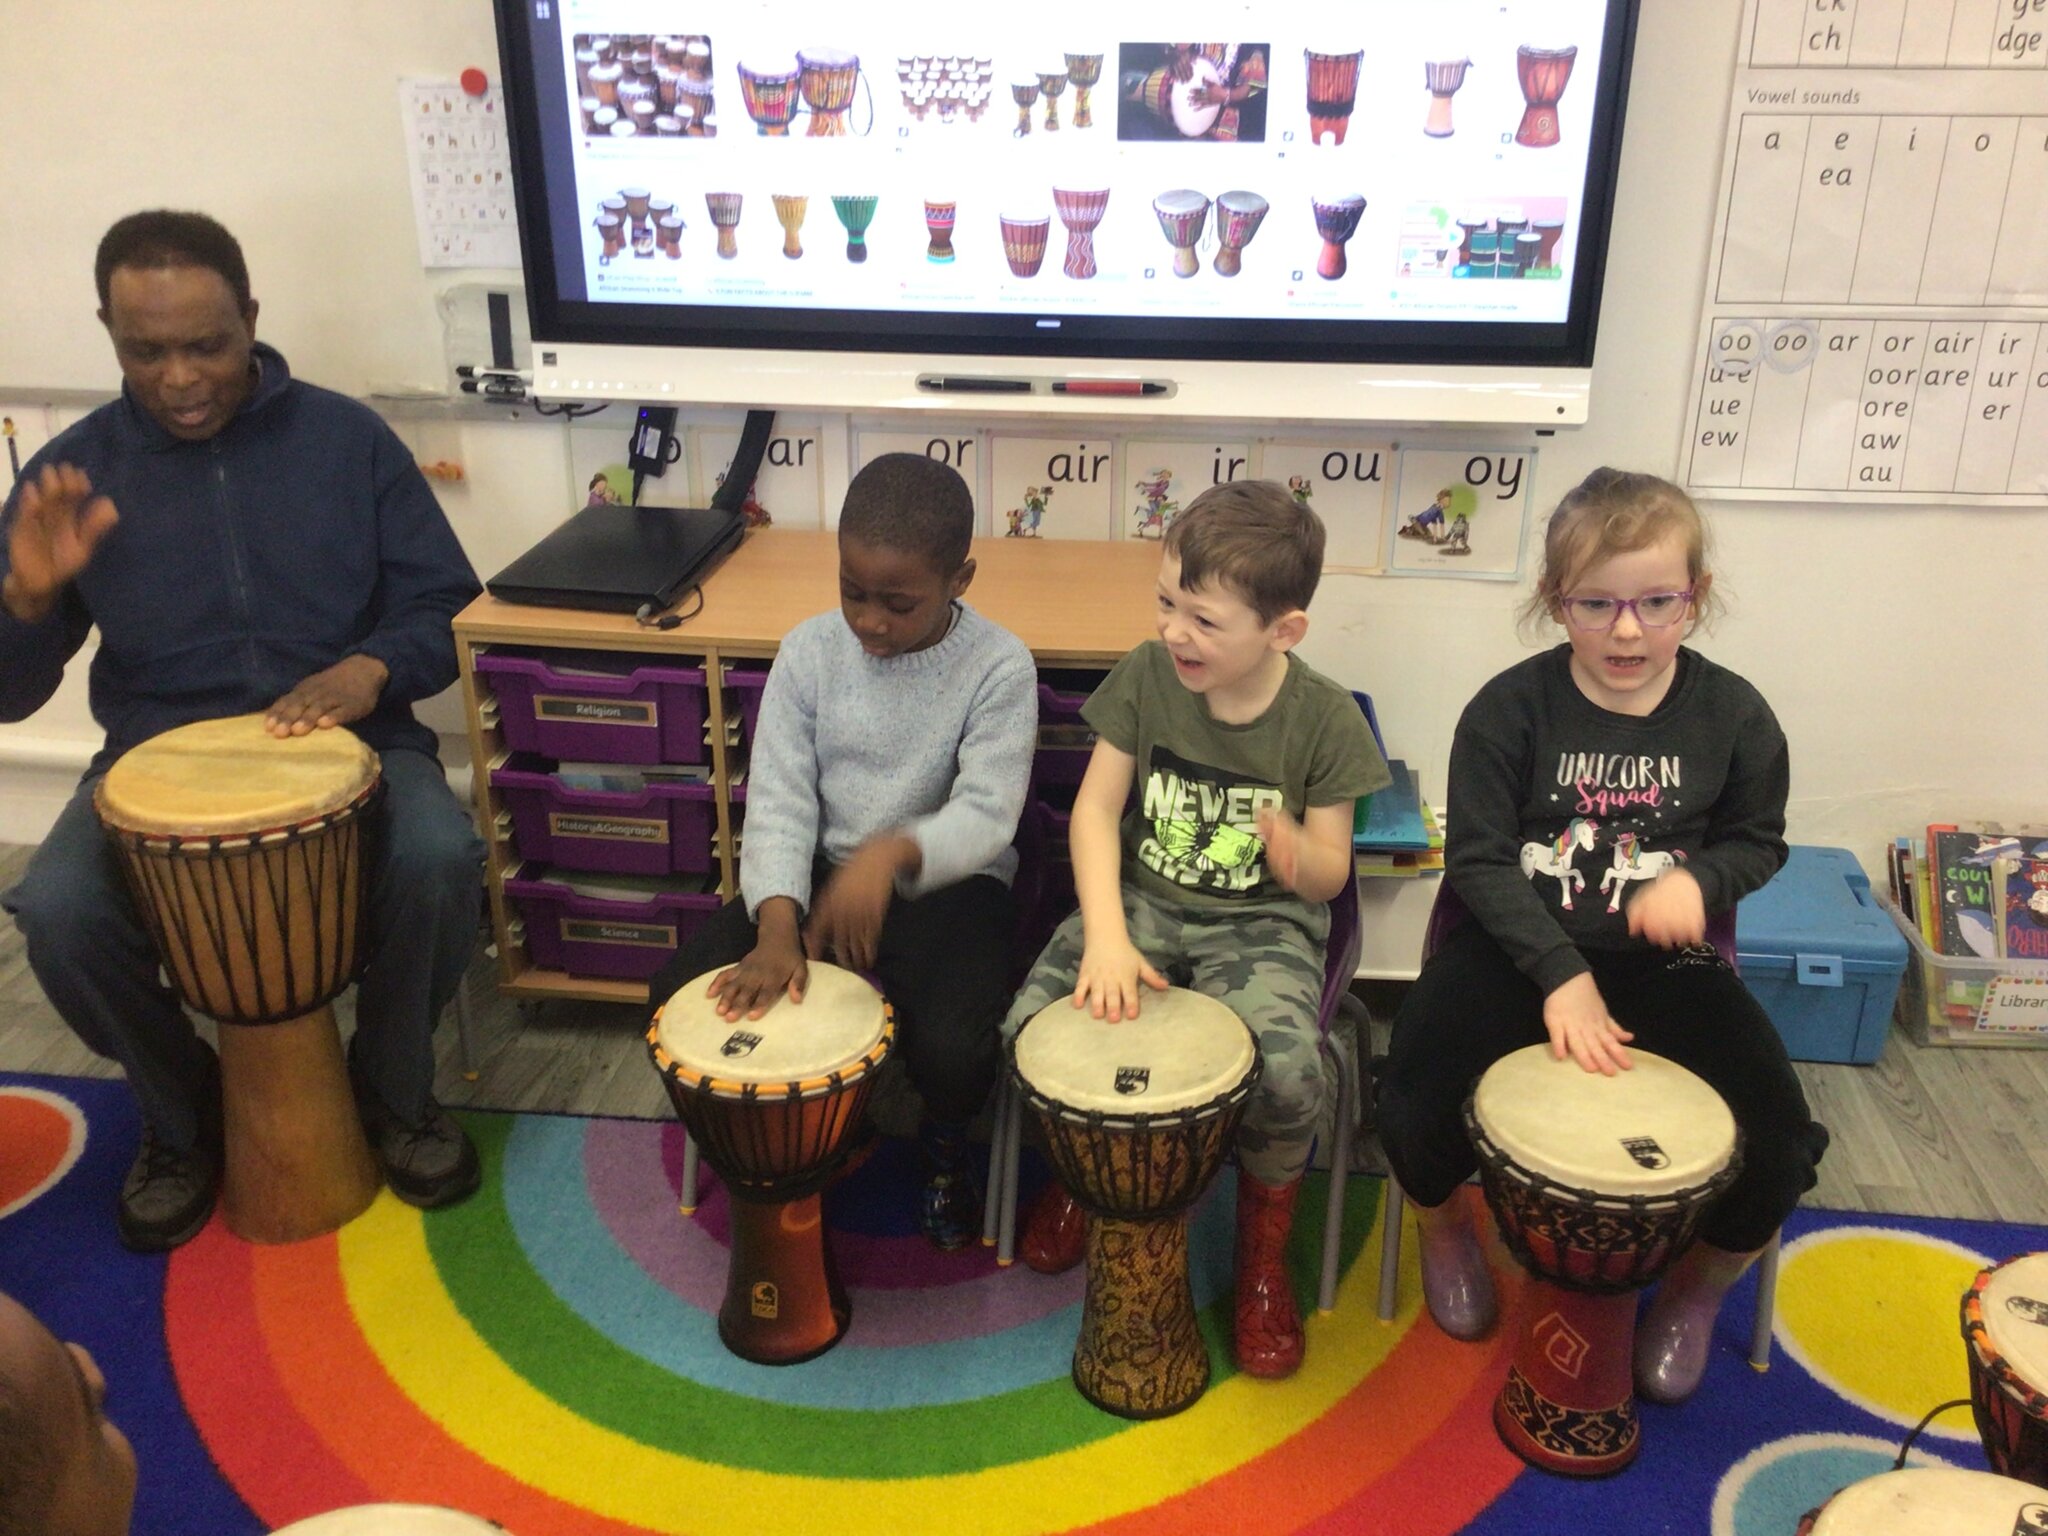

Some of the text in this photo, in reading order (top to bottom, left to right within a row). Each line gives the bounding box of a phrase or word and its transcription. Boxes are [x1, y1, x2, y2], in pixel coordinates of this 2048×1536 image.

[1809, 24, 1842, 50] ch
[1998, 24, 2042, 59] dge
[1747, 88, 1860, 104] Vowel sounds
[1764, 127, 1990, 152] a e i o
[1819, 167, 1852, 186] ea
[1719, 332, 2021, 354] oo oo ar or air ir
[1868, 367, 1917, 386] oor
[1924, 368, 1970, 386] are
[1988, 371, 2019, 387] ur
[1710, 399, 2011, 420] ue ore er
[767, 437, 814, 467] ar
[926, 438, 973, 467] or
[1701, 430, 1901, 450] ew aw
[1047, 444, 1109, 483] air
[1212, 447, 1245, 484] ir
[1321, 450, 1381, 482] ou
[1859, 465, 1892, 483] au
[1464, 455, 1523, 500] oy
[576, 704, 621, 718] Religion
[1557, 752, 1680, 789] UNICORN
[1575, 776, 1664, 816] Squad
[601, 927, 639, 940] Science
[2000, 993, 2048, 1008] Librar
